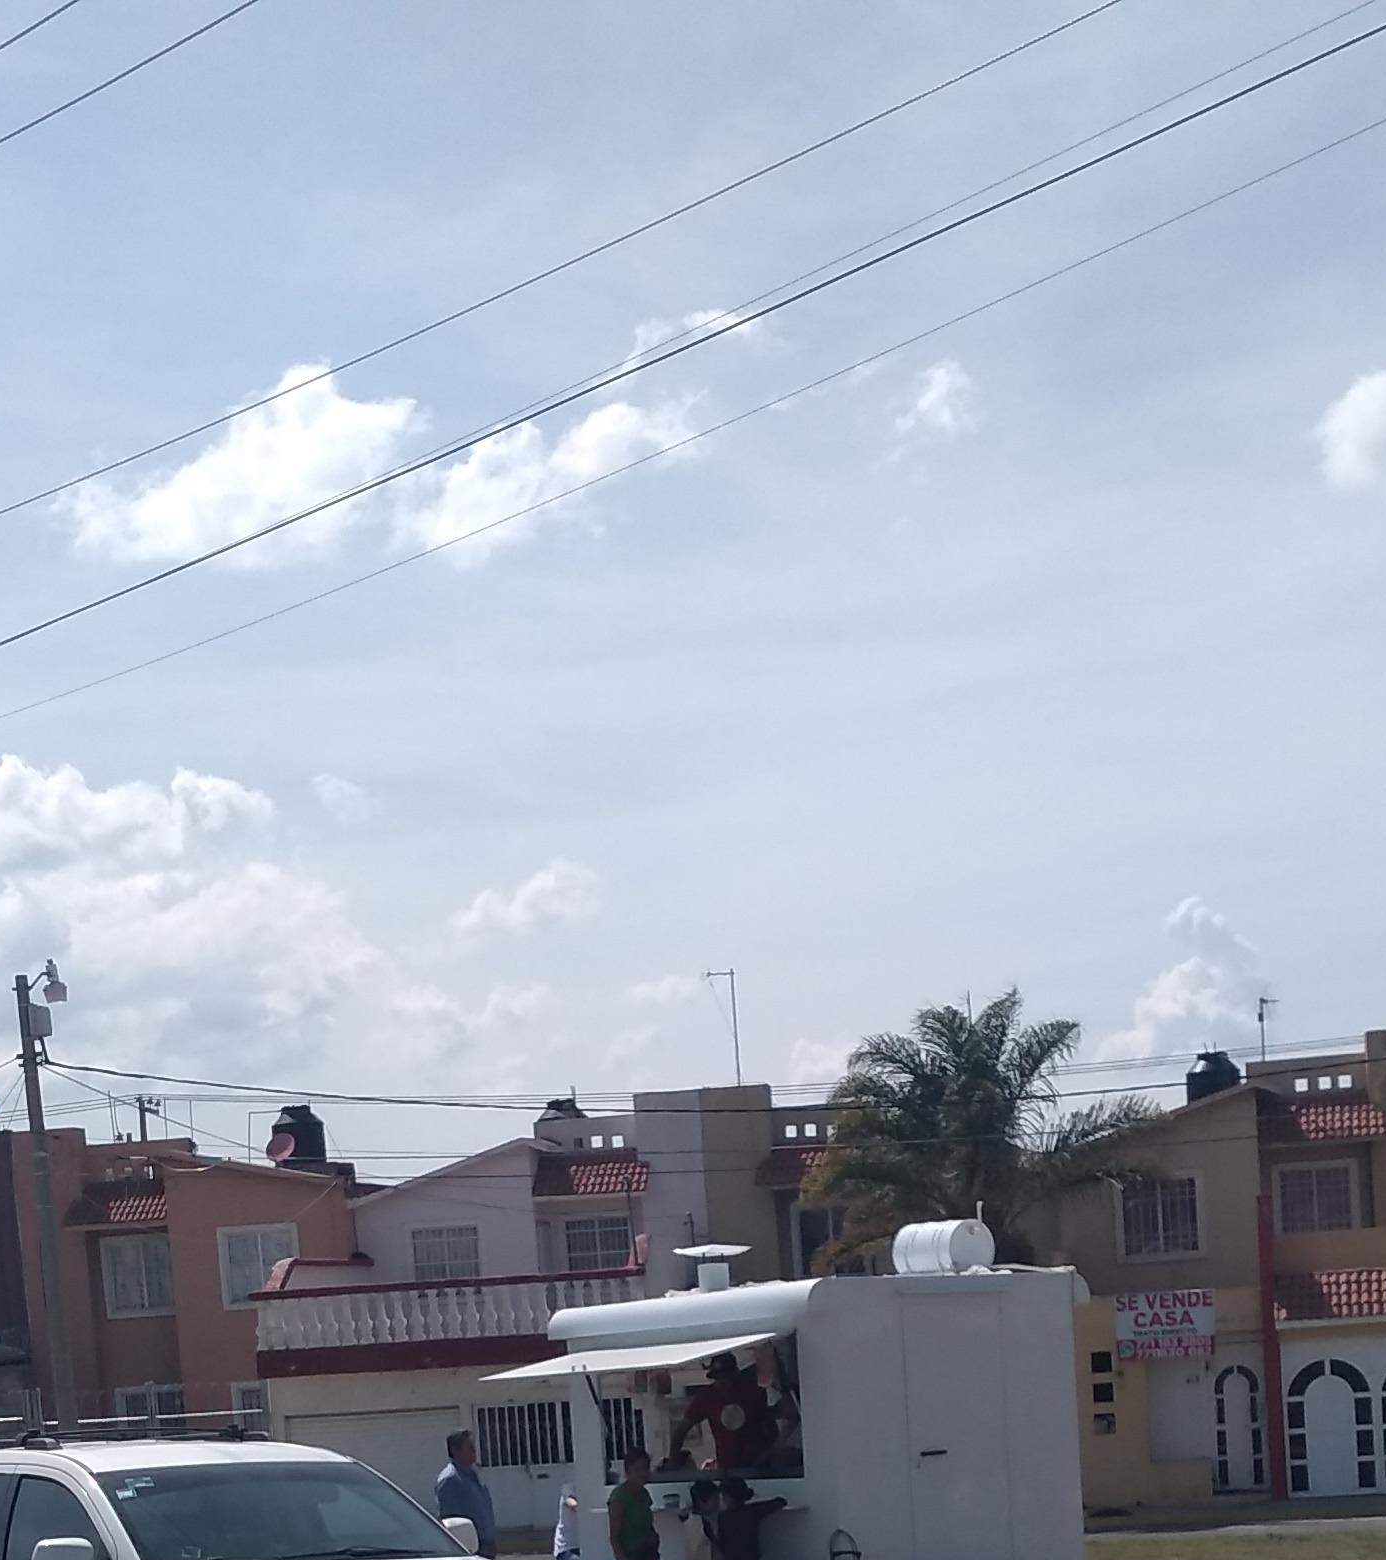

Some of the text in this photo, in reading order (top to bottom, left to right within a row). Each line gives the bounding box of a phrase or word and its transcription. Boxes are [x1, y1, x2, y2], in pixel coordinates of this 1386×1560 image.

[1116, 1291, 1213, 1312] SE VENDE
[1133, 1310, 1194, 1328] CASA
